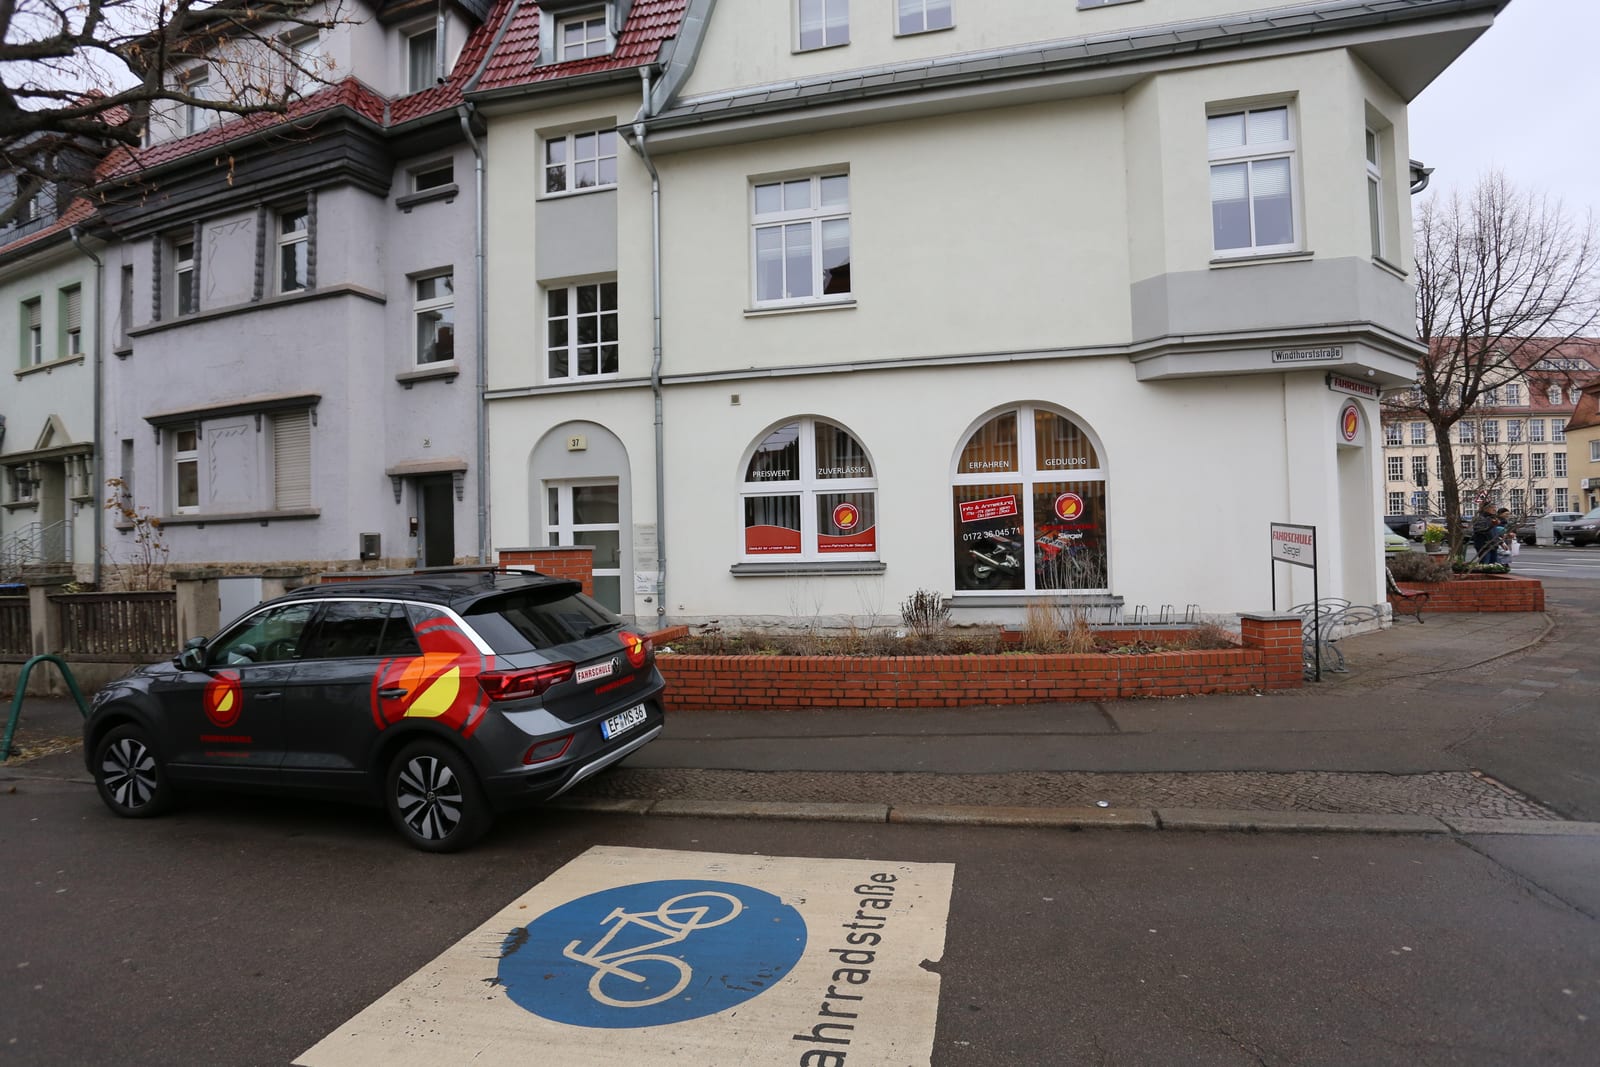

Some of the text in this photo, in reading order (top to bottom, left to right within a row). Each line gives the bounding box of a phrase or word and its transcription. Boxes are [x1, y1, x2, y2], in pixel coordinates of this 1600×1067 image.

[1275, 347, 1340, 360] Windthorststraße
[1334, 377, 1374, 395] FAHRSCHULE
[571, 438, 580, 447] 37
[969, 460, 1009, 469] ERFAHREN
[1045, 457, 1087, 466] GEDULDIG
[752, 469, 791, 477] PREISWERT
[818, 465, 866, 475] ZUVERLÄSSIG
[963, 531, 982, 541] 0172
[994, 528, 1010, 537] 045
[1011, 527, 1020, 535] 71
[1272, 530, 1313, 546] FAHRSCHULE
[577, 663, 612, 681] FAHRSCHULE
[608, 716, 619, 733] EF
[622, 710, 634, 726] MS
[633, 705, 644, 720] 36
